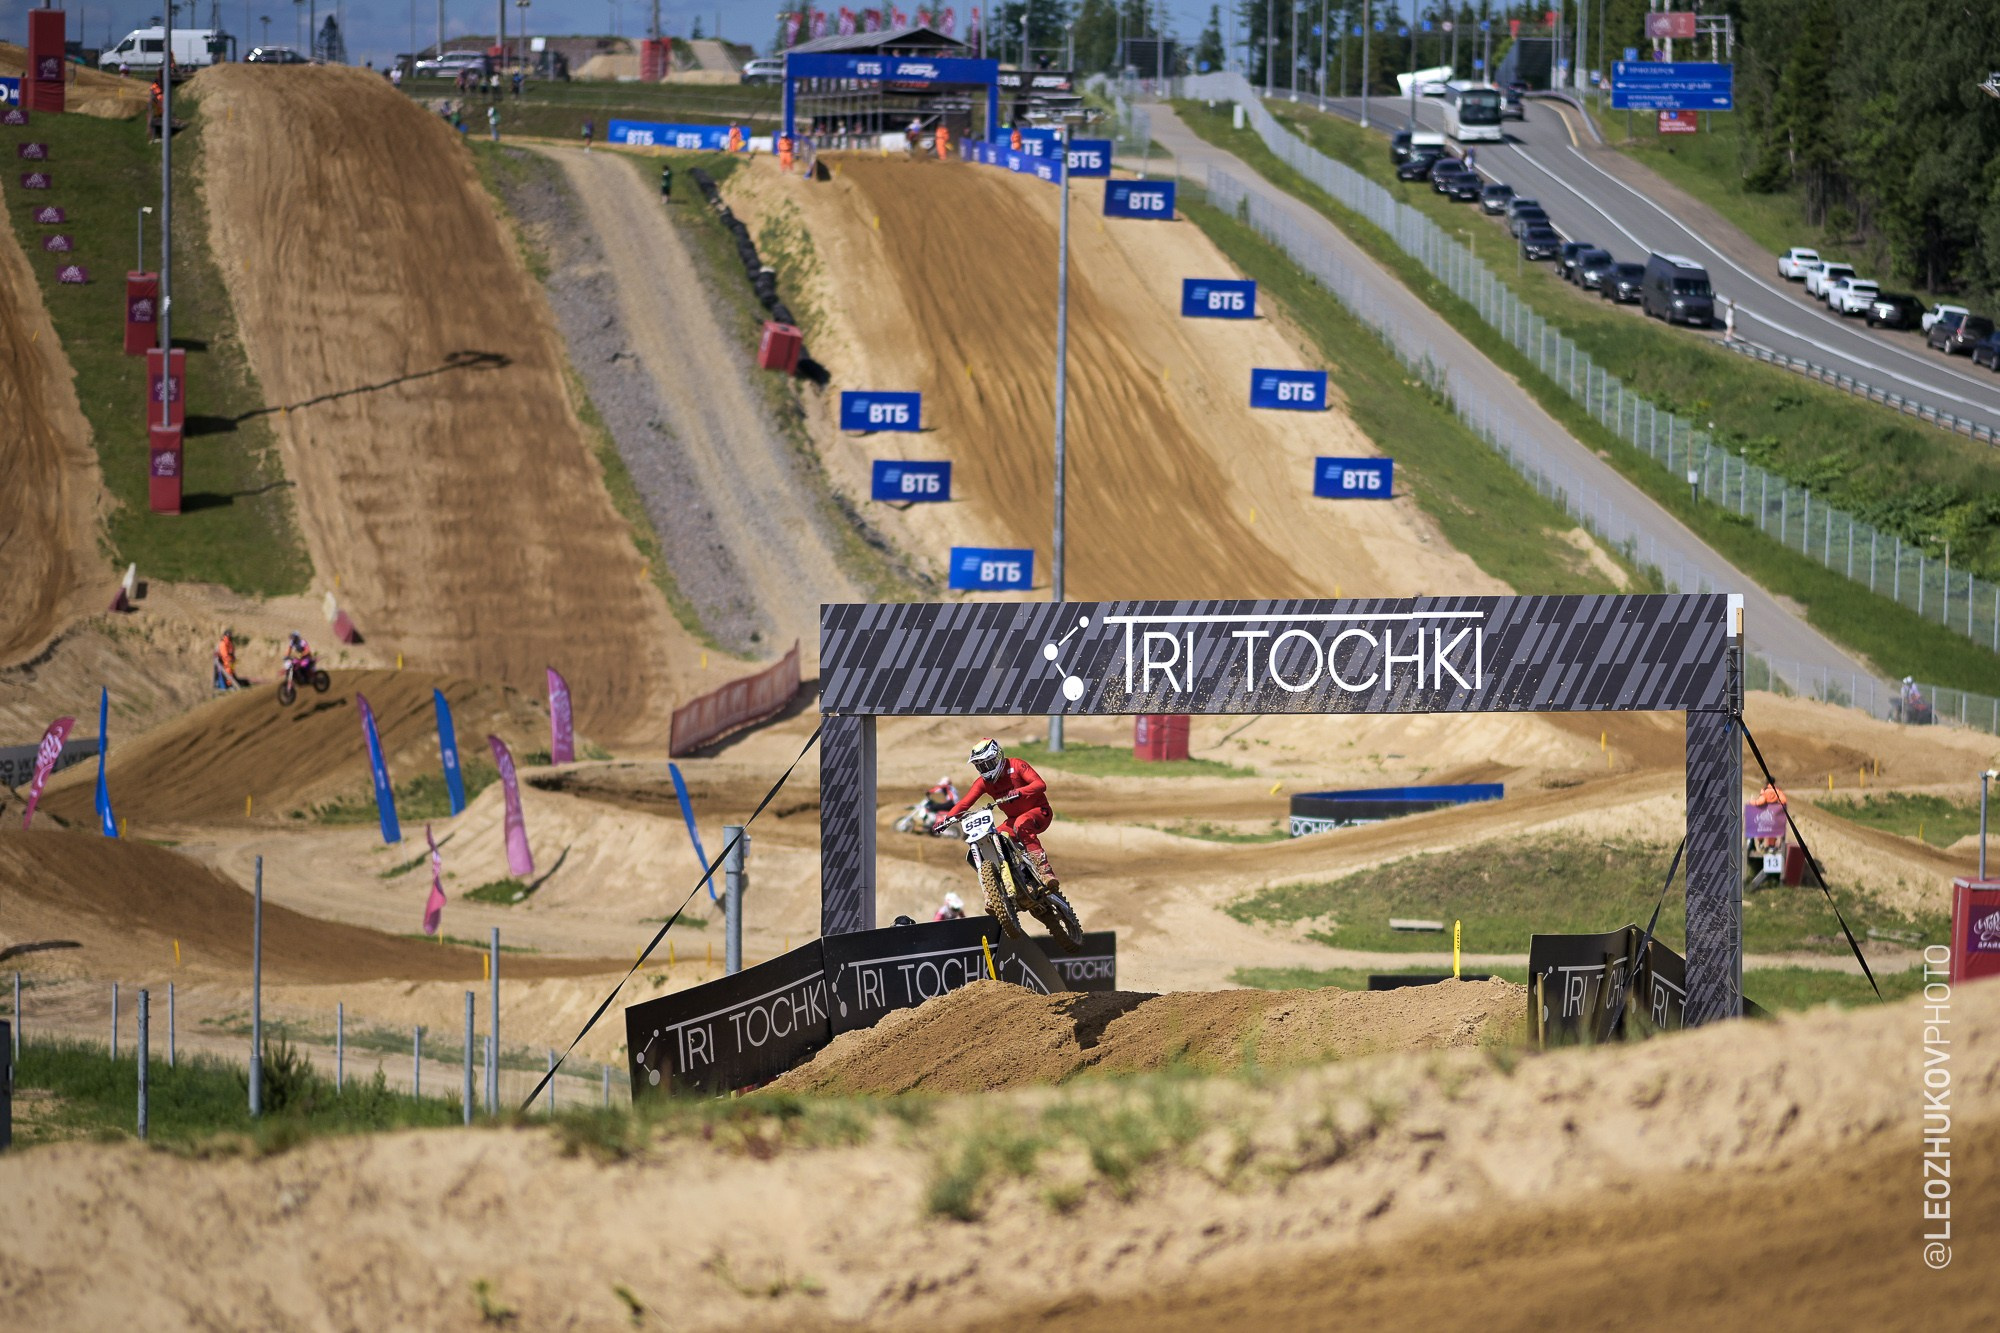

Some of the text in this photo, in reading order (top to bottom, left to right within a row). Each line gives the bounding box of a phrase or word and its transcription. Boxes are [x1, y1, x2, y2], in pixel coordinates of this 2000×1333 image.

[1067, 152, 1102, 168] ВТБ
[1129, 192, 1165, 210] ВТБ
[1208, 291, 1245, 310] ВТБ
[1278, 382, 1316, 401] ВТБ
[869, 404, 909, 423] ВТБ
[901, 474, 940, 493] ВТБ
[1342, 470, 1381, 489] ВТБ
[980, 561, 1021, 582] ВТБ
[1103, 616, 1483, 693] TRI TOCHKI
[1767, 858, 1779, 867] 13
[1065, 960, 1114, 980] TOCHKI
[848, 953, 996, 1010] TRI TOCHK
[1558, 965, 1588, 1017] TRI
[666, 979, 830, 1073] TRI TOCHKI
